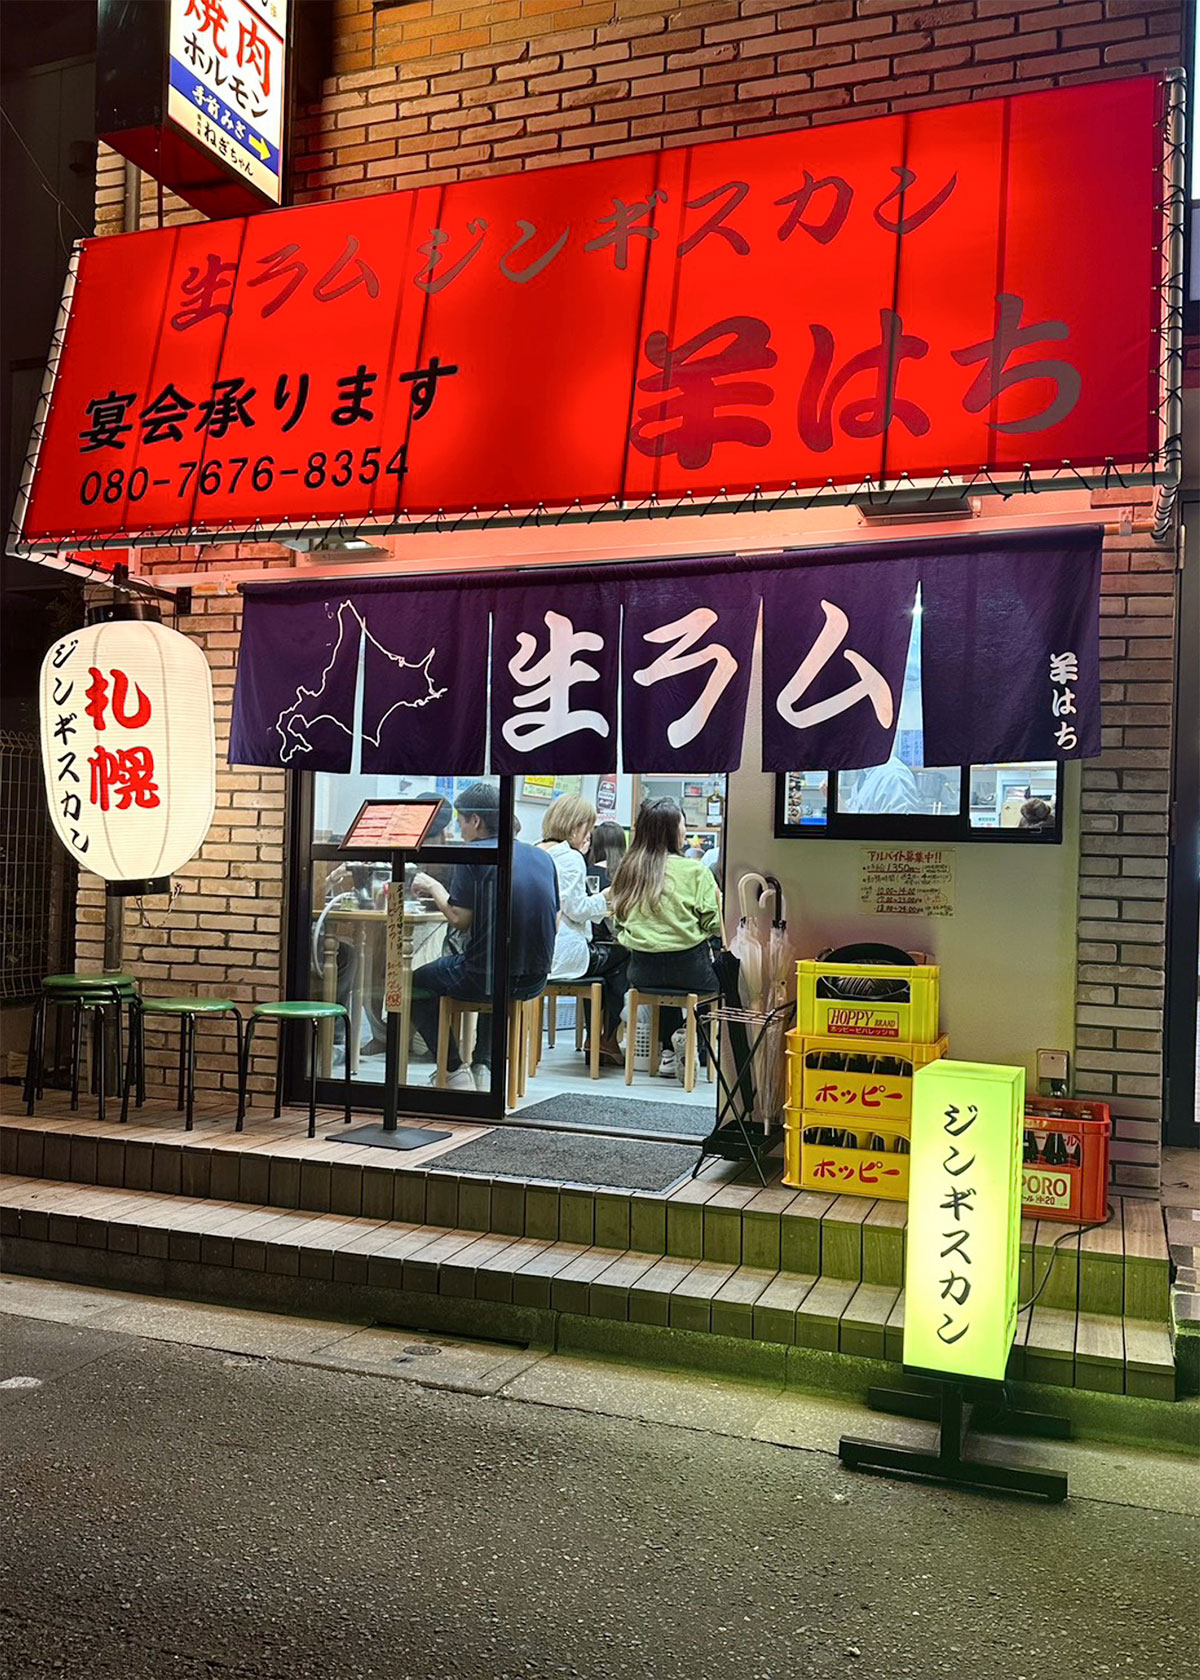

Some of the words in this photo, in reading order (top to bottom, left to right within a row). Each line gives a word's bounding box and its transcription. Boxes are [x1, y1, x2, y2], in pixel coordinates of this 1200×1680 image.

[183, 0, 271, 97] 焼肉
[184, 32, 268, 118] ホルモン
[204, 122, 254, 176] ねぎちゃん
[79, 356, 458, 453] 宴会承ります
[629, 293, 1082, 470] 羊はち
[80, 444, 409, 506] 080-7676-8354
[501, 599, 894, 752] 生ラム
[1048, 651, 1080, 751] 羊はち
[52, 639, 89, 854] ジンギスカン
[84, 666, 161, 812] 札幌
[831, 1008, 874, 1026] HOPPY
[815, 1082, 903, 1108] ホッピー
[813, 1157, 901, 1184] ホッピー
[936, 1103, 979, 1345] ジンギスカン
